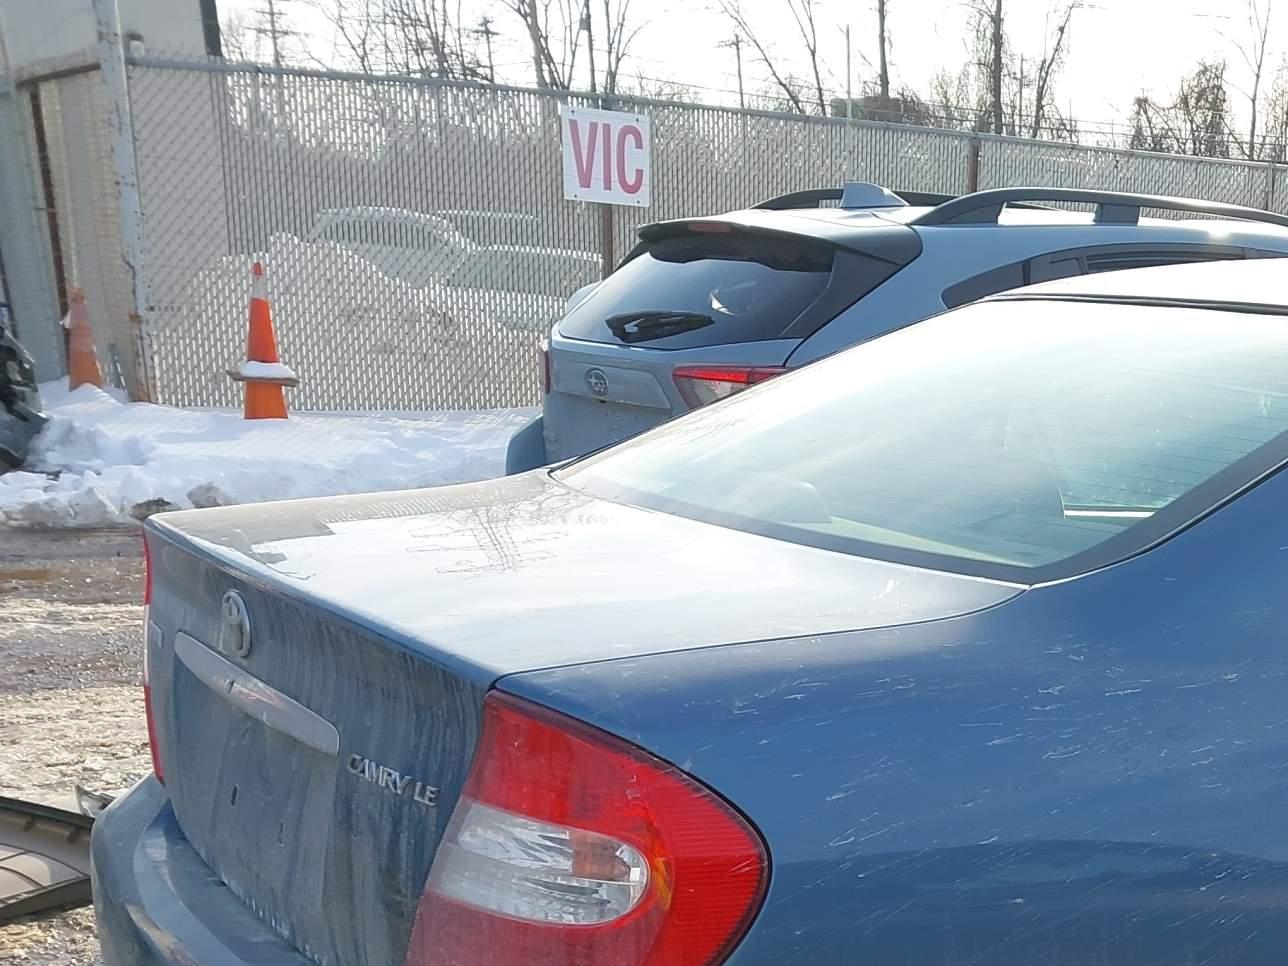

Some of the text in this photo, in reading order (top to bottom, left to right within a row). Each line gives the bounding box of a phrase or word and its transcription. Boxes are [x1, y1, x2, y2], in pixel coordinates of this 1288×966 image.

[568, 119, 643, 194] VIC
[347, 753, 440, 806] CAMRY LE
